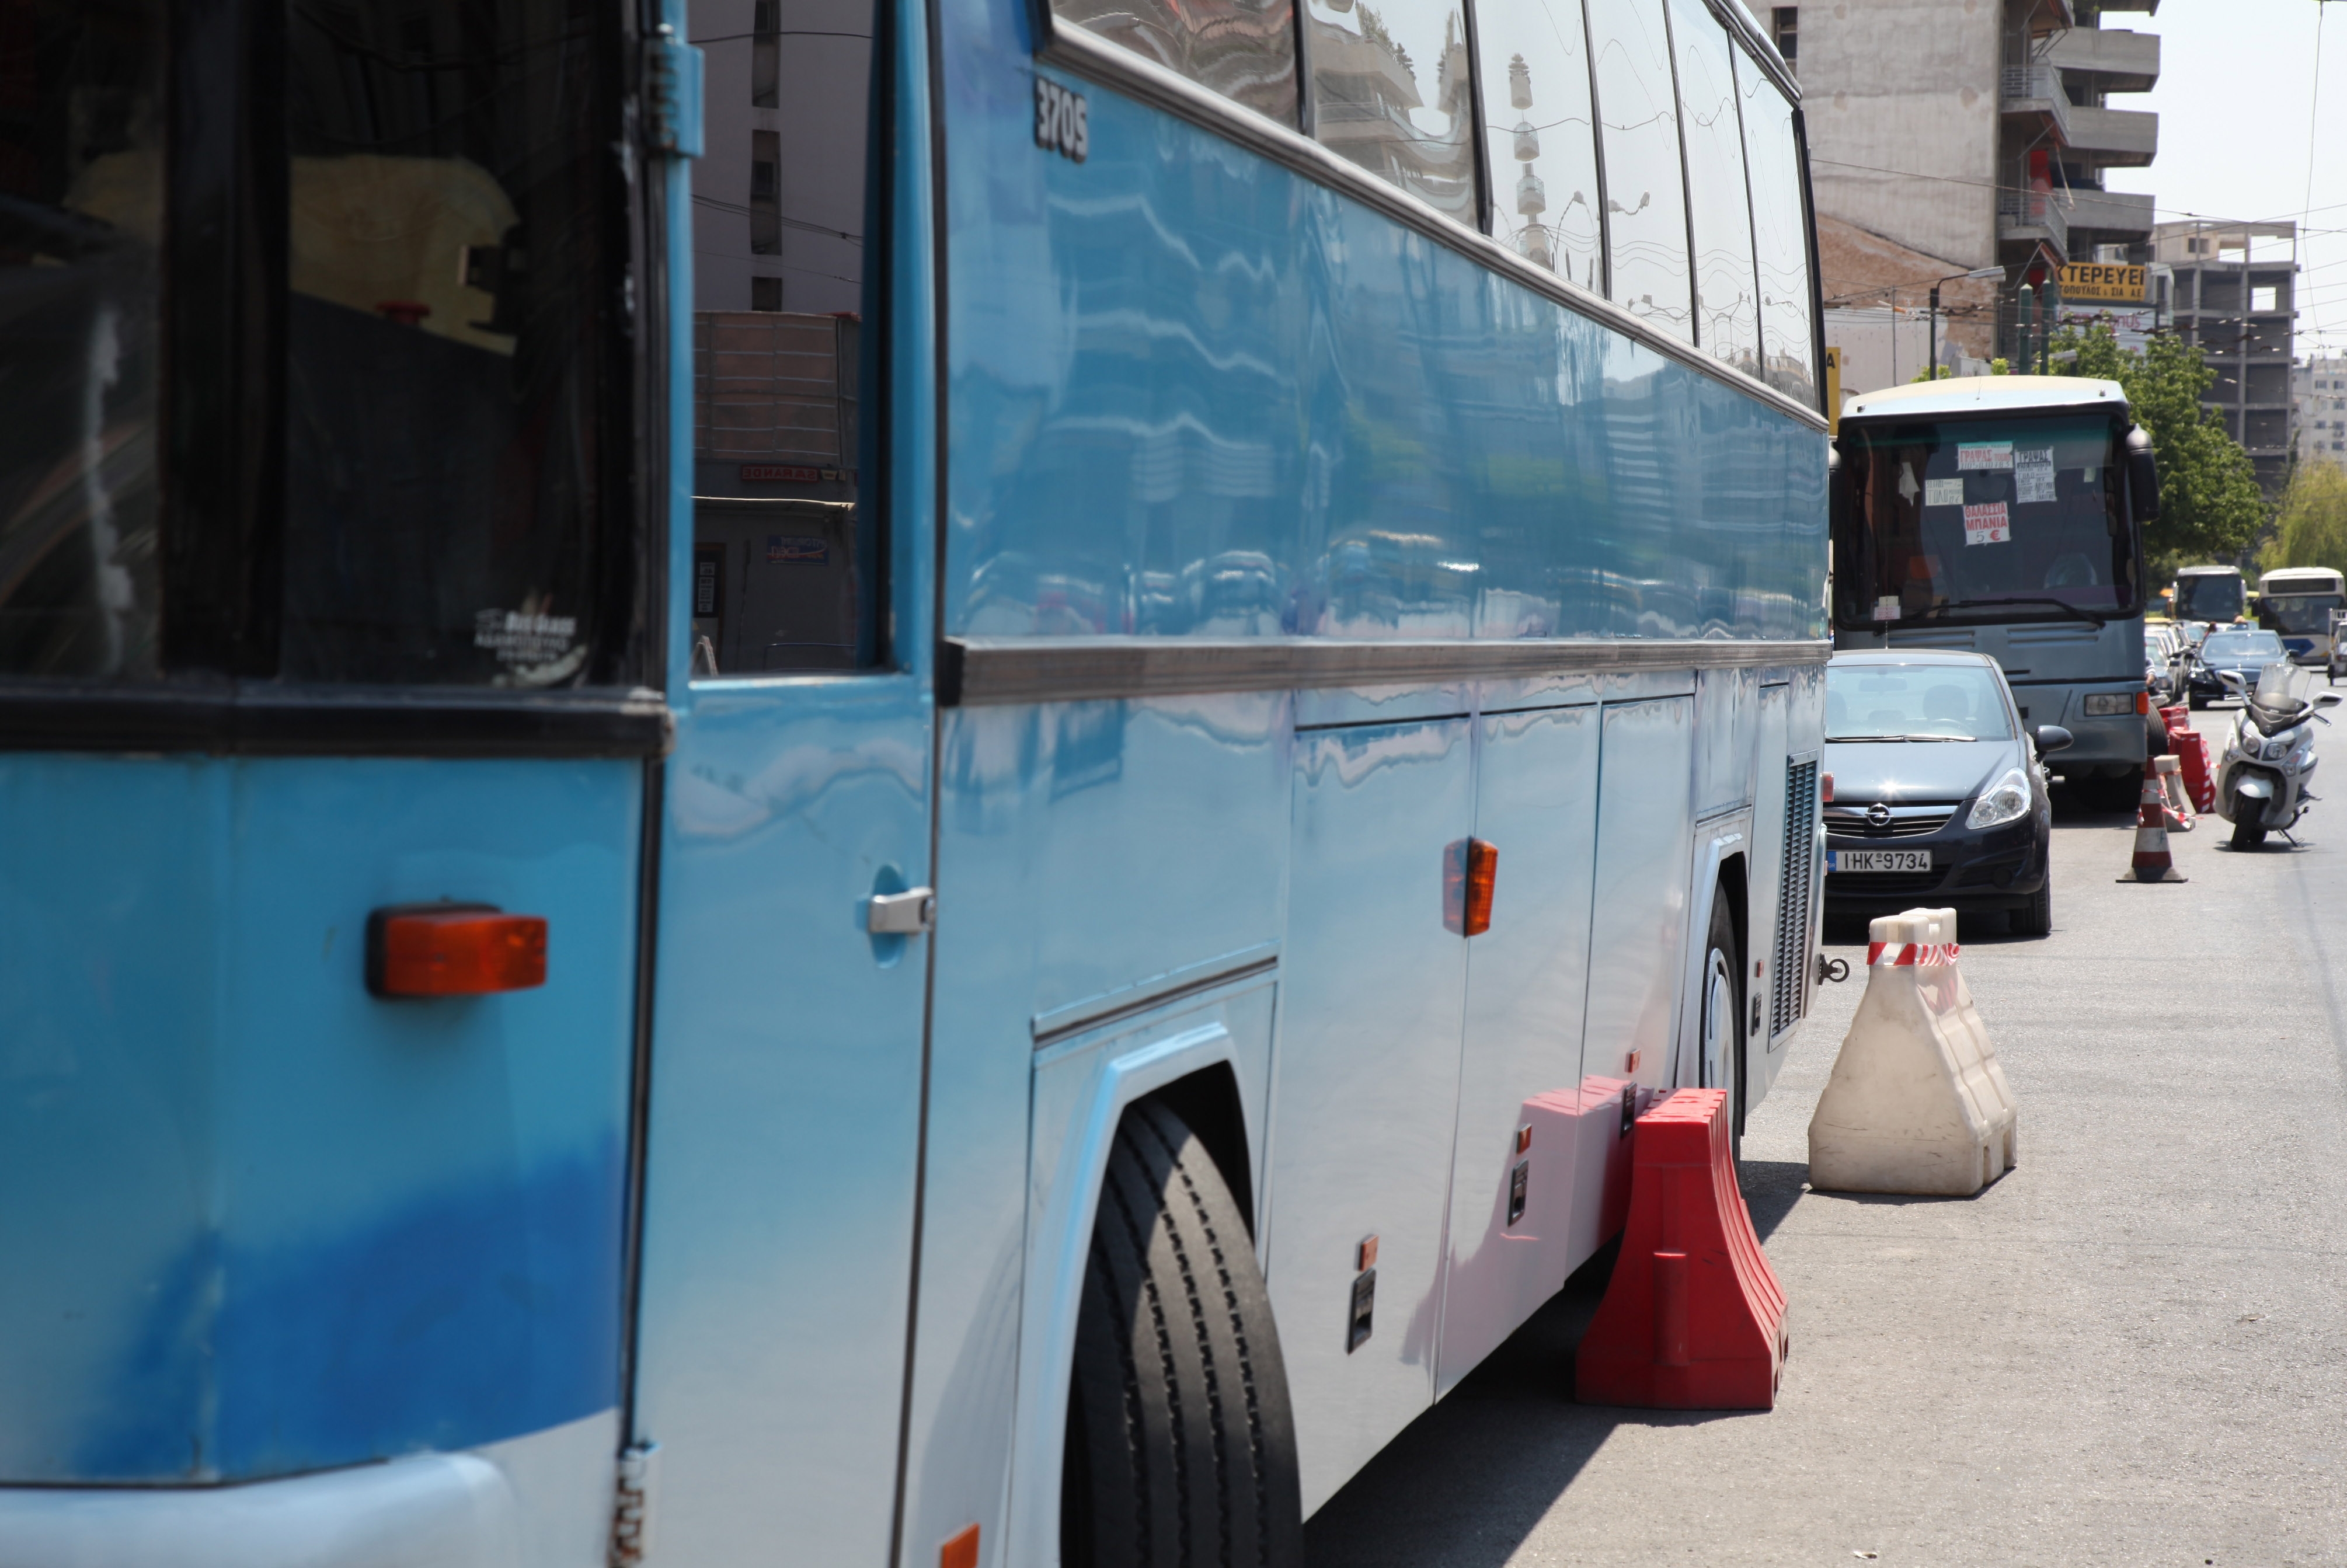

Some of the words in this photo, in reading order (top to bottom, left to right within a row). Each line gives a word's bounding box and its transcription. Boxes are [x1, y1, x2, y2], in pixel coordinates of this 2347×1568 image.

[2111, 287, 2123, 296] ΣΙΑ
[1961, 449, 1993, 462] ΓΡΑΨΑΣ
[2019, 450, 2049, 463] ΓΡΑΨΑΣ
[1965, 502, 2007, 518] ΘΑΛΑΣΣΙΑ
[1966, 516, 2008, 531] ΜΠΑΝΙΑ
[1976, 531, 1985, 542] 5
[1845, 853, 1928, 869] IHK-9734
